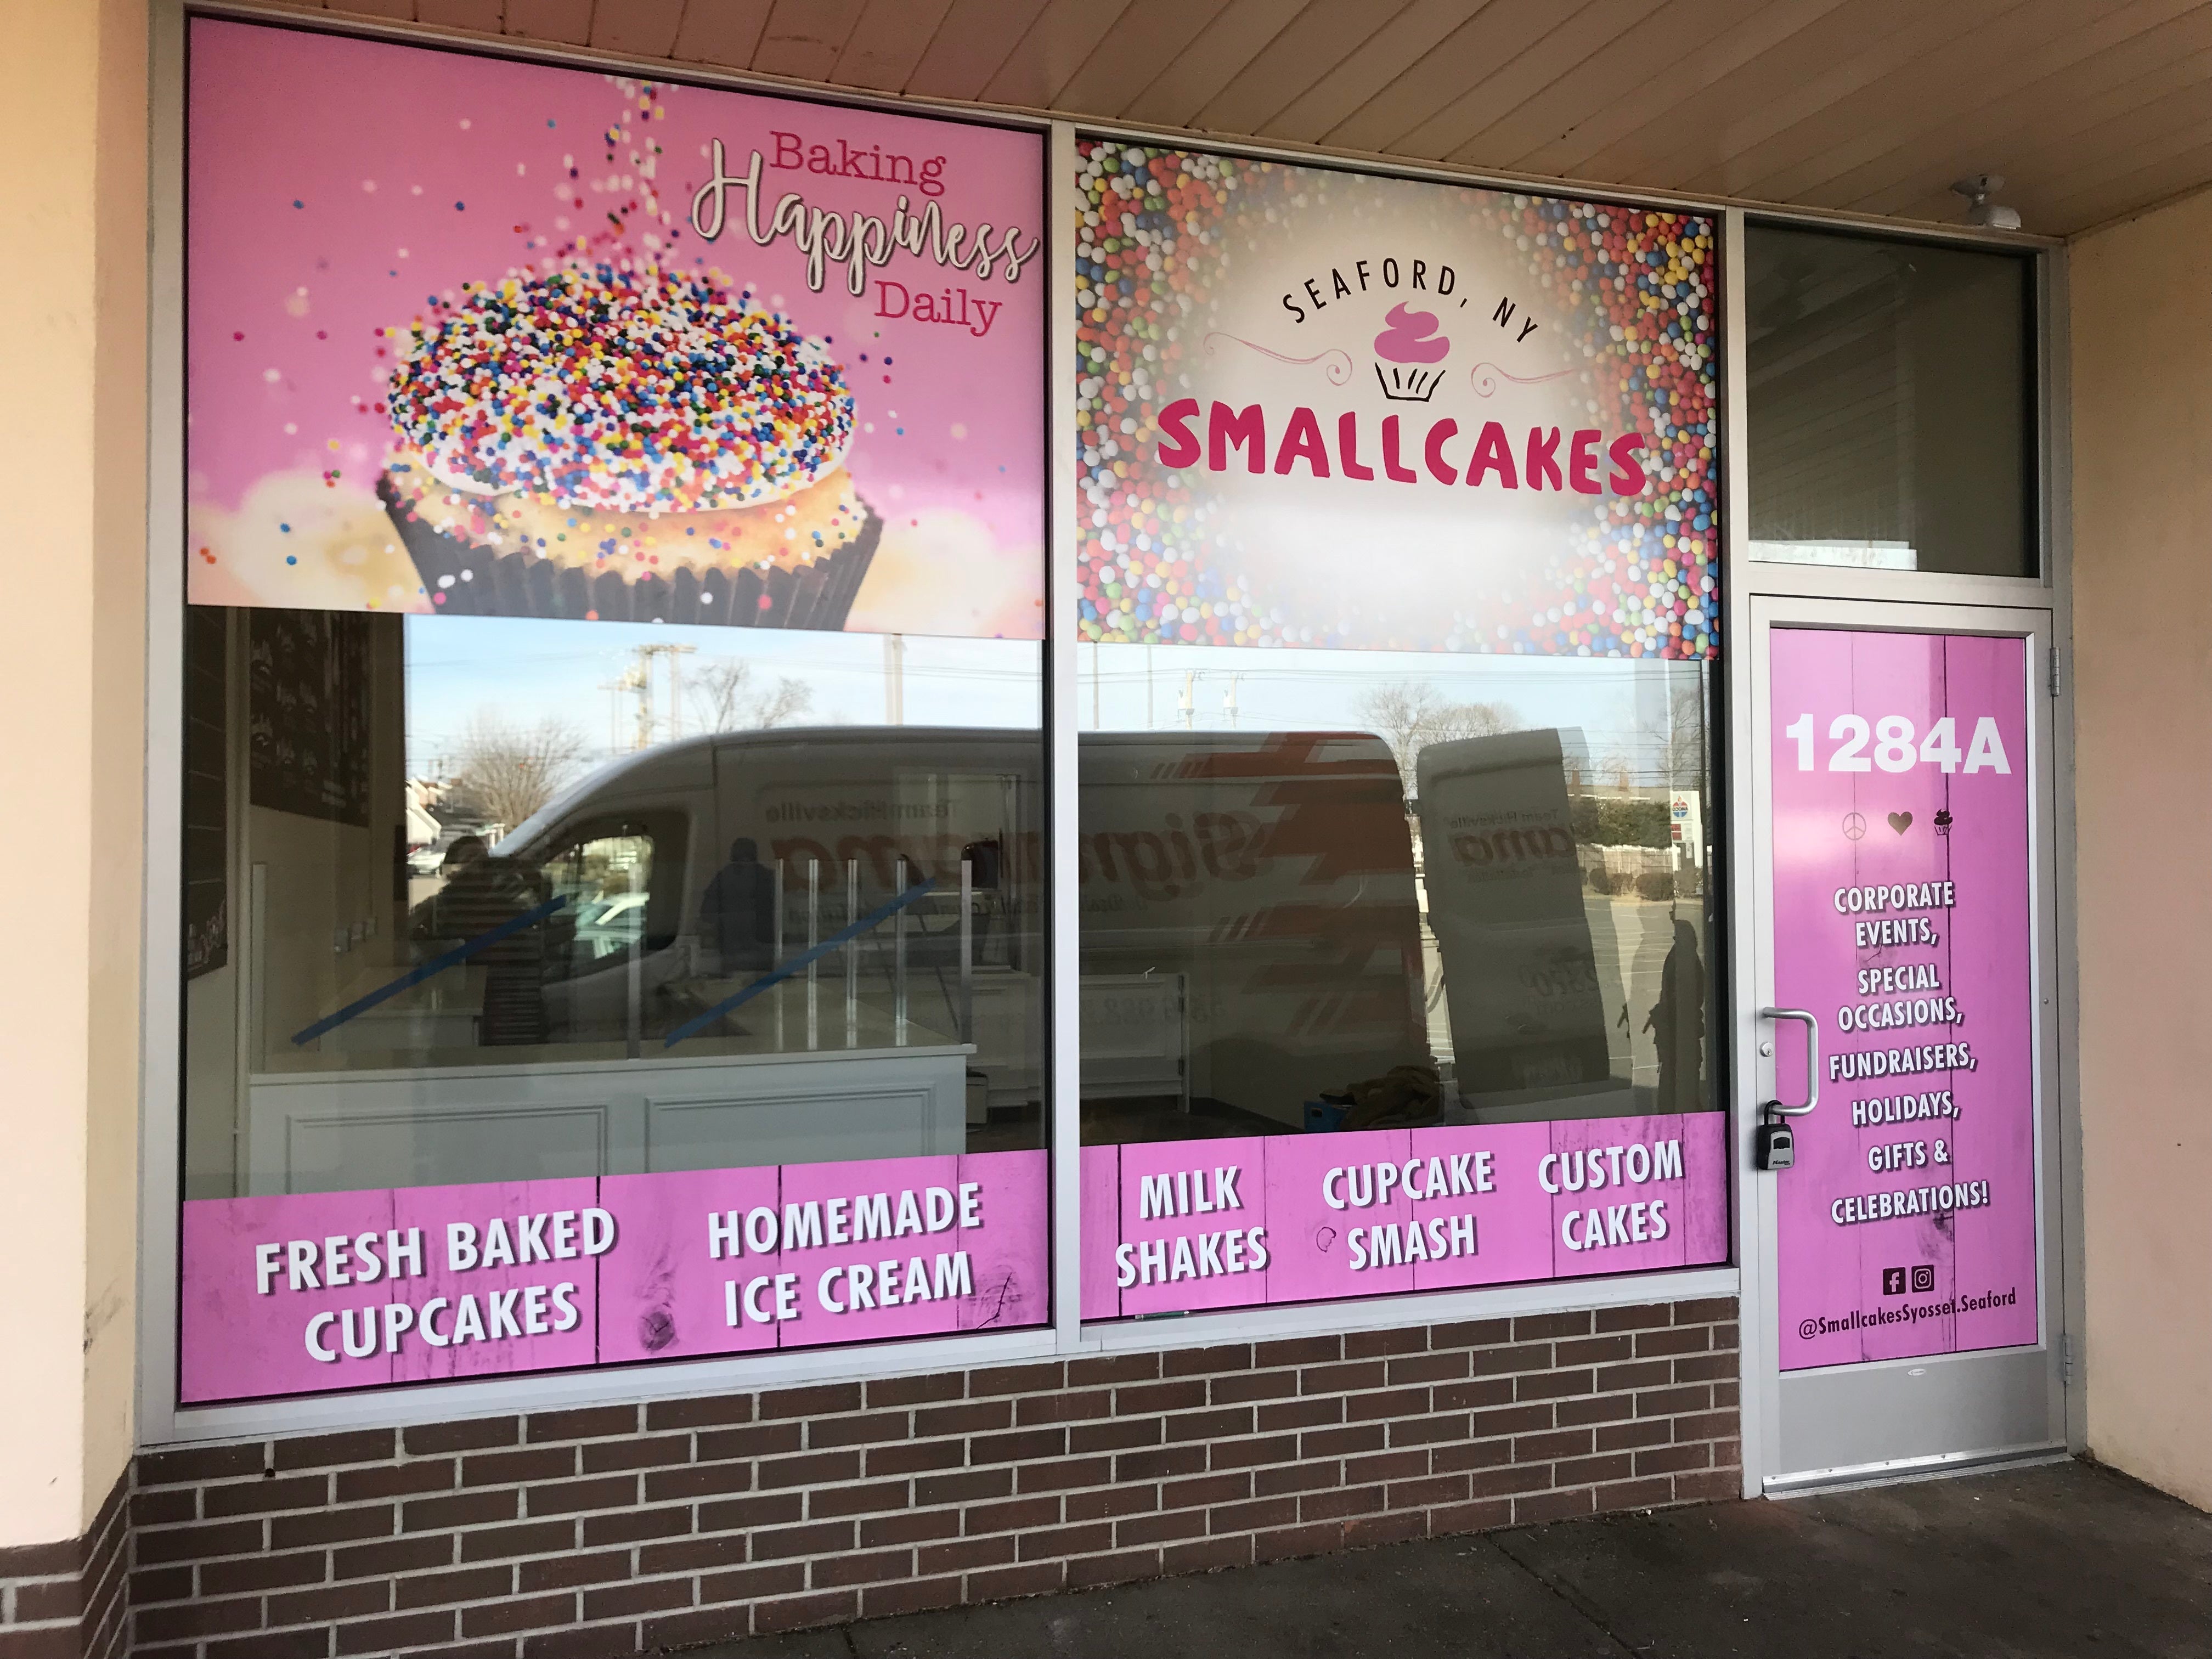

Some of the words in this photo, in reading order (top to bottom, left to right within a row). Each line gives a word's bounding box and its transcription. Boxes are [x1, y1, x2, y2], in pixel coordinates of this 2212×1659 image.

[770, 131, 946, 196] Baking
[692, 138, 1040, 296] Happiness
[874, 280, 1002, 337] Daily
[1283, 258, 1468, 324] SEAFORD,
[1493, 297, 1538, 343] NY
[1158, 398, 1646, 495] SMALLCAKES
[1786, 713, 2012, 774] 1284A
[1834, 882, 1954, 912] CORPORATE
[1856, 918, 1937, 946] EVENTS,
[1858, 964, 1939, 994] SPECIAL
[1838, 997, 1963, 1030] OCCASIONS,
[1830, 1043, 1976, 1080] FUNDRAISERS,
[1852, 1092, 1959, 1125] HOLIDAYS,
[1323, 1151, 1493, 1209] CUPCAKE
[1538, 1141, 1682, 1194] CUSTOM
[1869, 1142, 1926, 1171] GIFTS
[1934, 1139, 1948, 1163] &
[1139, 1166, 1240, 1218] MILK
[1831, 1181, 1988, 1223] CELEBRATIONS!
[708, 1182, 980, 1258] HOMEMADE
[1348, 1214, 1476, 1269] SMASH
[1562, 1200, 1667, 1250] CAKES
[256, 1227, 421, 1294] FRESH
[447, 1208, 616, 1271] BAKED
[1116, 1227, 1267, 1288] SHAKES
[725, 1272, 798, 1326] ICE
[818, 1251, 972, 1312] CREAM
[1799, 1287, 2016, 1340] @SmallcakesSyosset.Seaford
[305, 1282, 578, 1361] CUPCAKES
